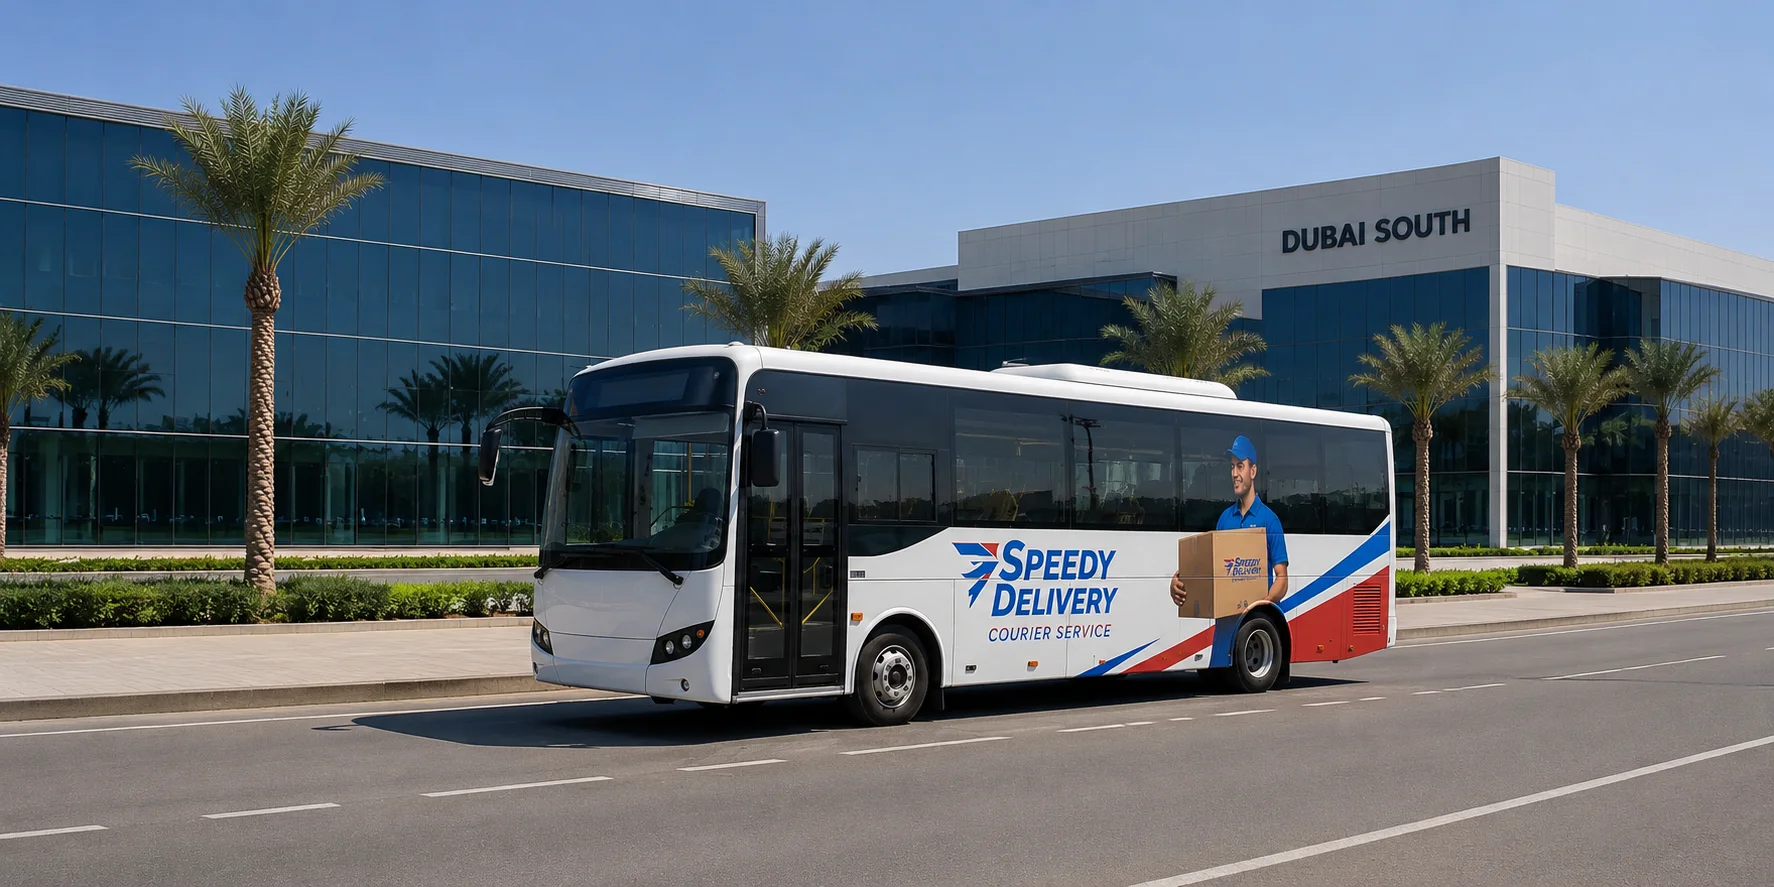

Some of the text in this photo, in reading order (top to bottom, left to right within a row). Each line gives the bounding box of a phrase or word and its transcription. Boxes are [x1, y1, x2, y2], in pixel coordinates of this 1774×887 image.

[1282, 208, 1470, 254] DUBAI SOUTH
[998, 539, 1117, 582] SPEEDY
[991, 583, 1119, 617] DELIVERY
[988, 623, 1112, 642] COURIER SERVICE
